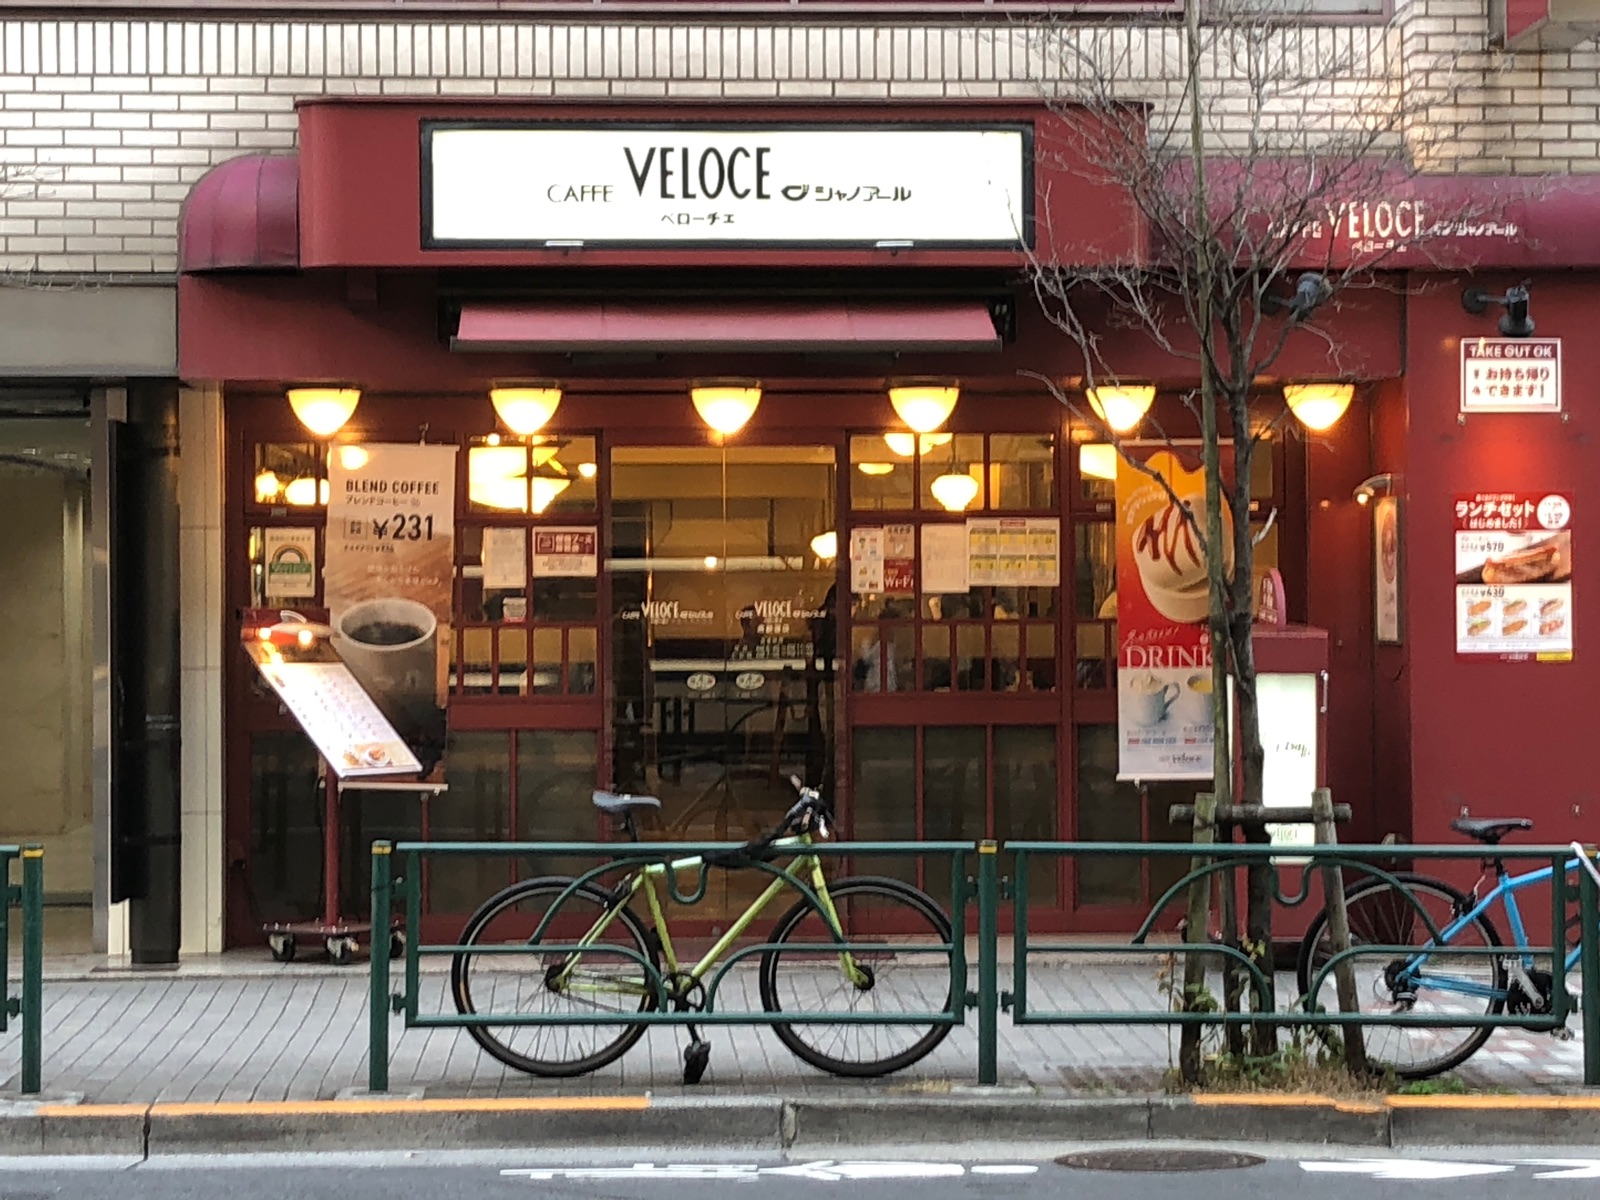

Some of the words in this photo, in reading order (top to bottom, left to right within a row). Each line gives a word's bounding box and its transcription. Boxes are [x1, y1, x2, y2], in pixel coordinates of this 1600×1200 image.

[547, 184, 614, 203] CAFFE
[623, 146, 771, 200] VELOCE
[815, 185, 912, 202] シャノアール
[1325, 201, 1425, 238] VELOCE
[1469, 344, 1502, 358] TAKE
[1504, 344, 1531, 358] OUT
[1533, 345, 1552, 358] OK
[1486, 366, 1550, 382] お持ち帰り
[345, 479, 388, 493] BLEND
[392, 480, 440, 495] COFFEE
[1456, 500, 1535, 518] ランチセット
[372, 512, 434, 542] ¥231
